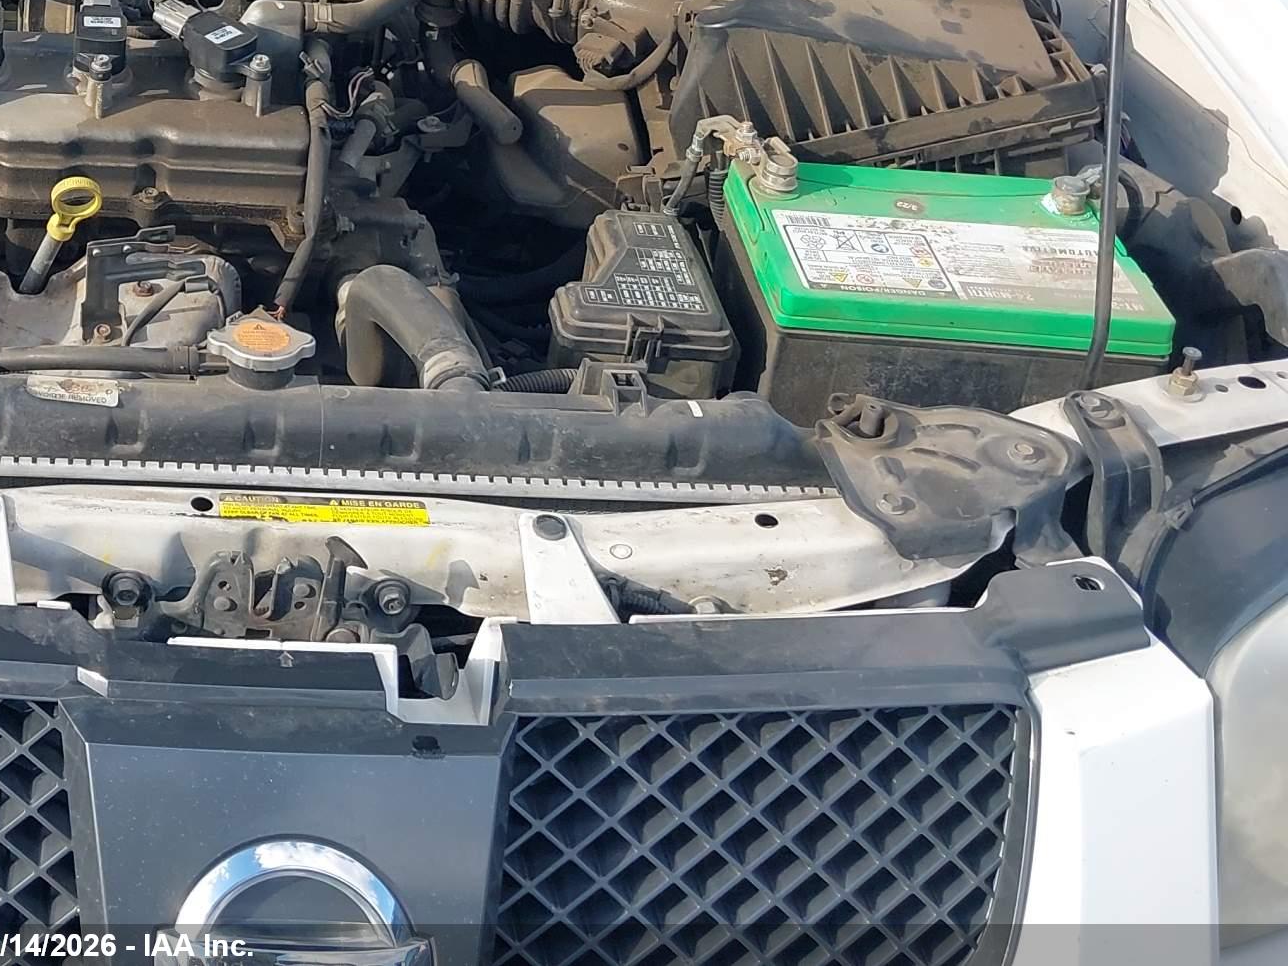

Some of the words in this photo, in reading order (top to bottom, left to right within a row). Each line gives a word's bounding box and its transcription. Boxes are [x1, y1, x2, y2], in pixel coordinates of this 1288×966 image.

[68, 395, 107, 404] REMOVED
[234, 495, 280, 503] CAUTION
[341, 499, 366, 507] MISE
[368, 500, 382, 508] EN
[384, 501, 421, 509] GARDE
